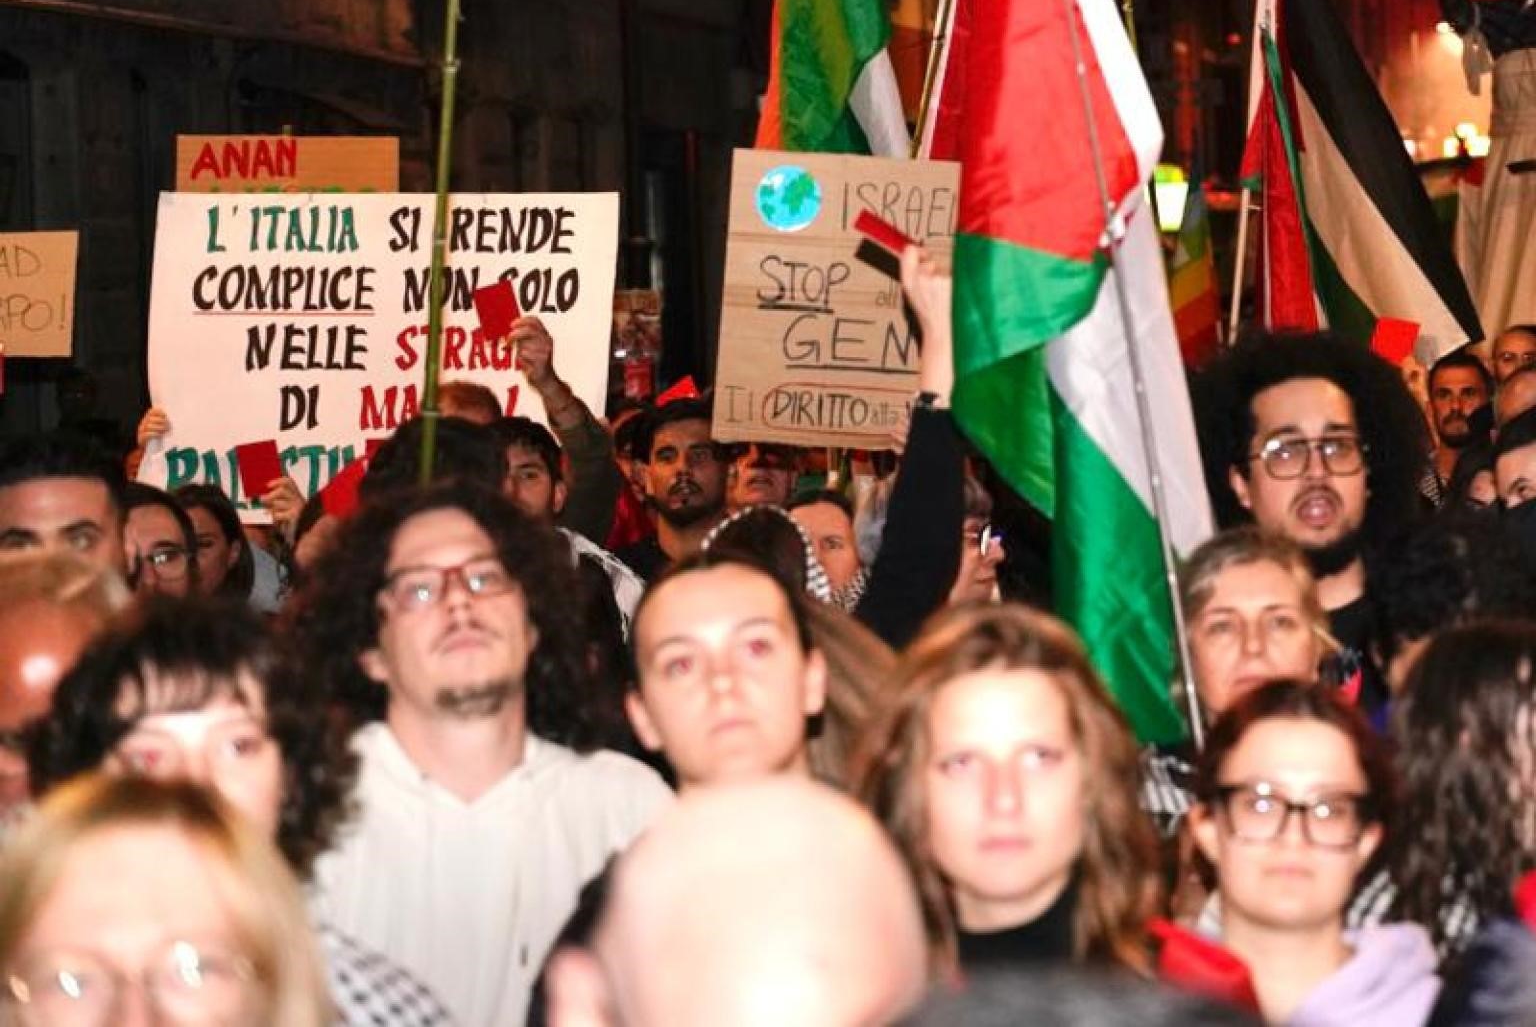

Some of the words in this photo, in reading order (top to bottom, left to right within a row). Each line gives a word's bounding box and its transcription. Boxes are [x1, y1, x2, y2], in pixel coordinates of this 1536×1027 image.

[388, 205, 420, 254] SI
[449, 206, 576, 255] RENDE
[192, 264, 377, 312] COMPLICE
[756, 254, 851, 307] STOP
[244, 322, 368, 372] NELLE
[278, 383, 320, 431] DI
[772, 389, 869, 429] DIRITTO
